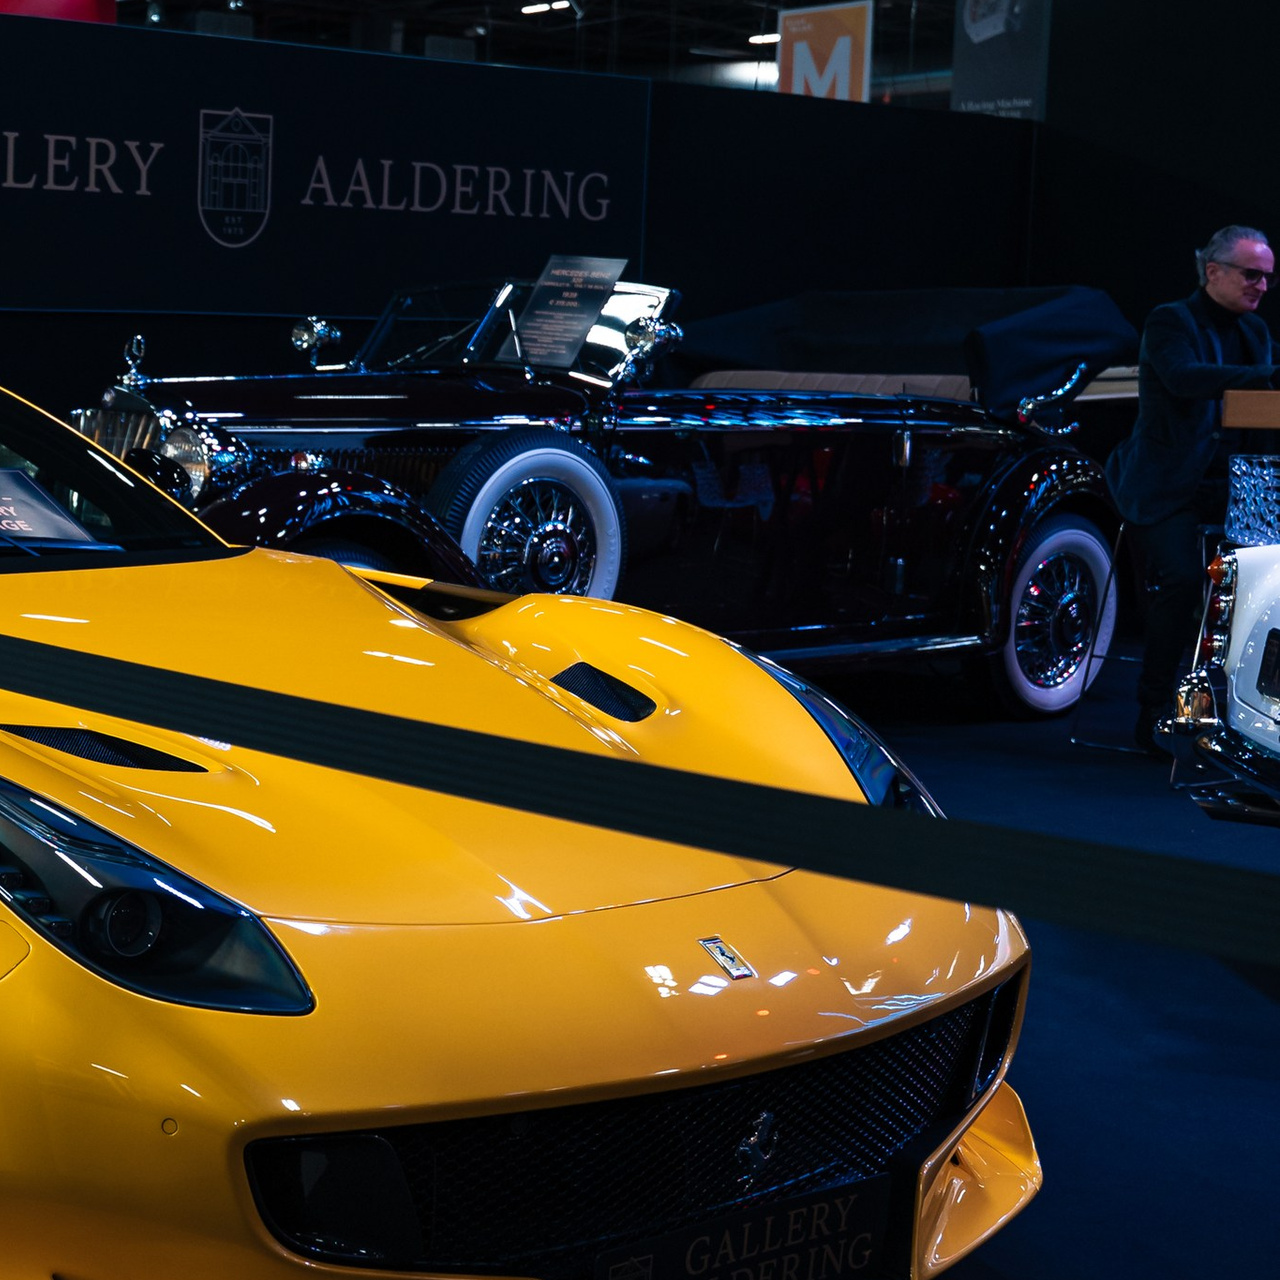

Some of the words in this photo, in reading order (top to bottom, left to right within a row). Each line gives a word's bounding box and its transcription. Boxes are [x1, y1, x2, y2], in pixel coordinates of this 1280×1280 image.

[791, 34, 852, 99] M
[300, 155, 611, 223] AALDERING
[684, 1194, 859, 1277] GALLERY
